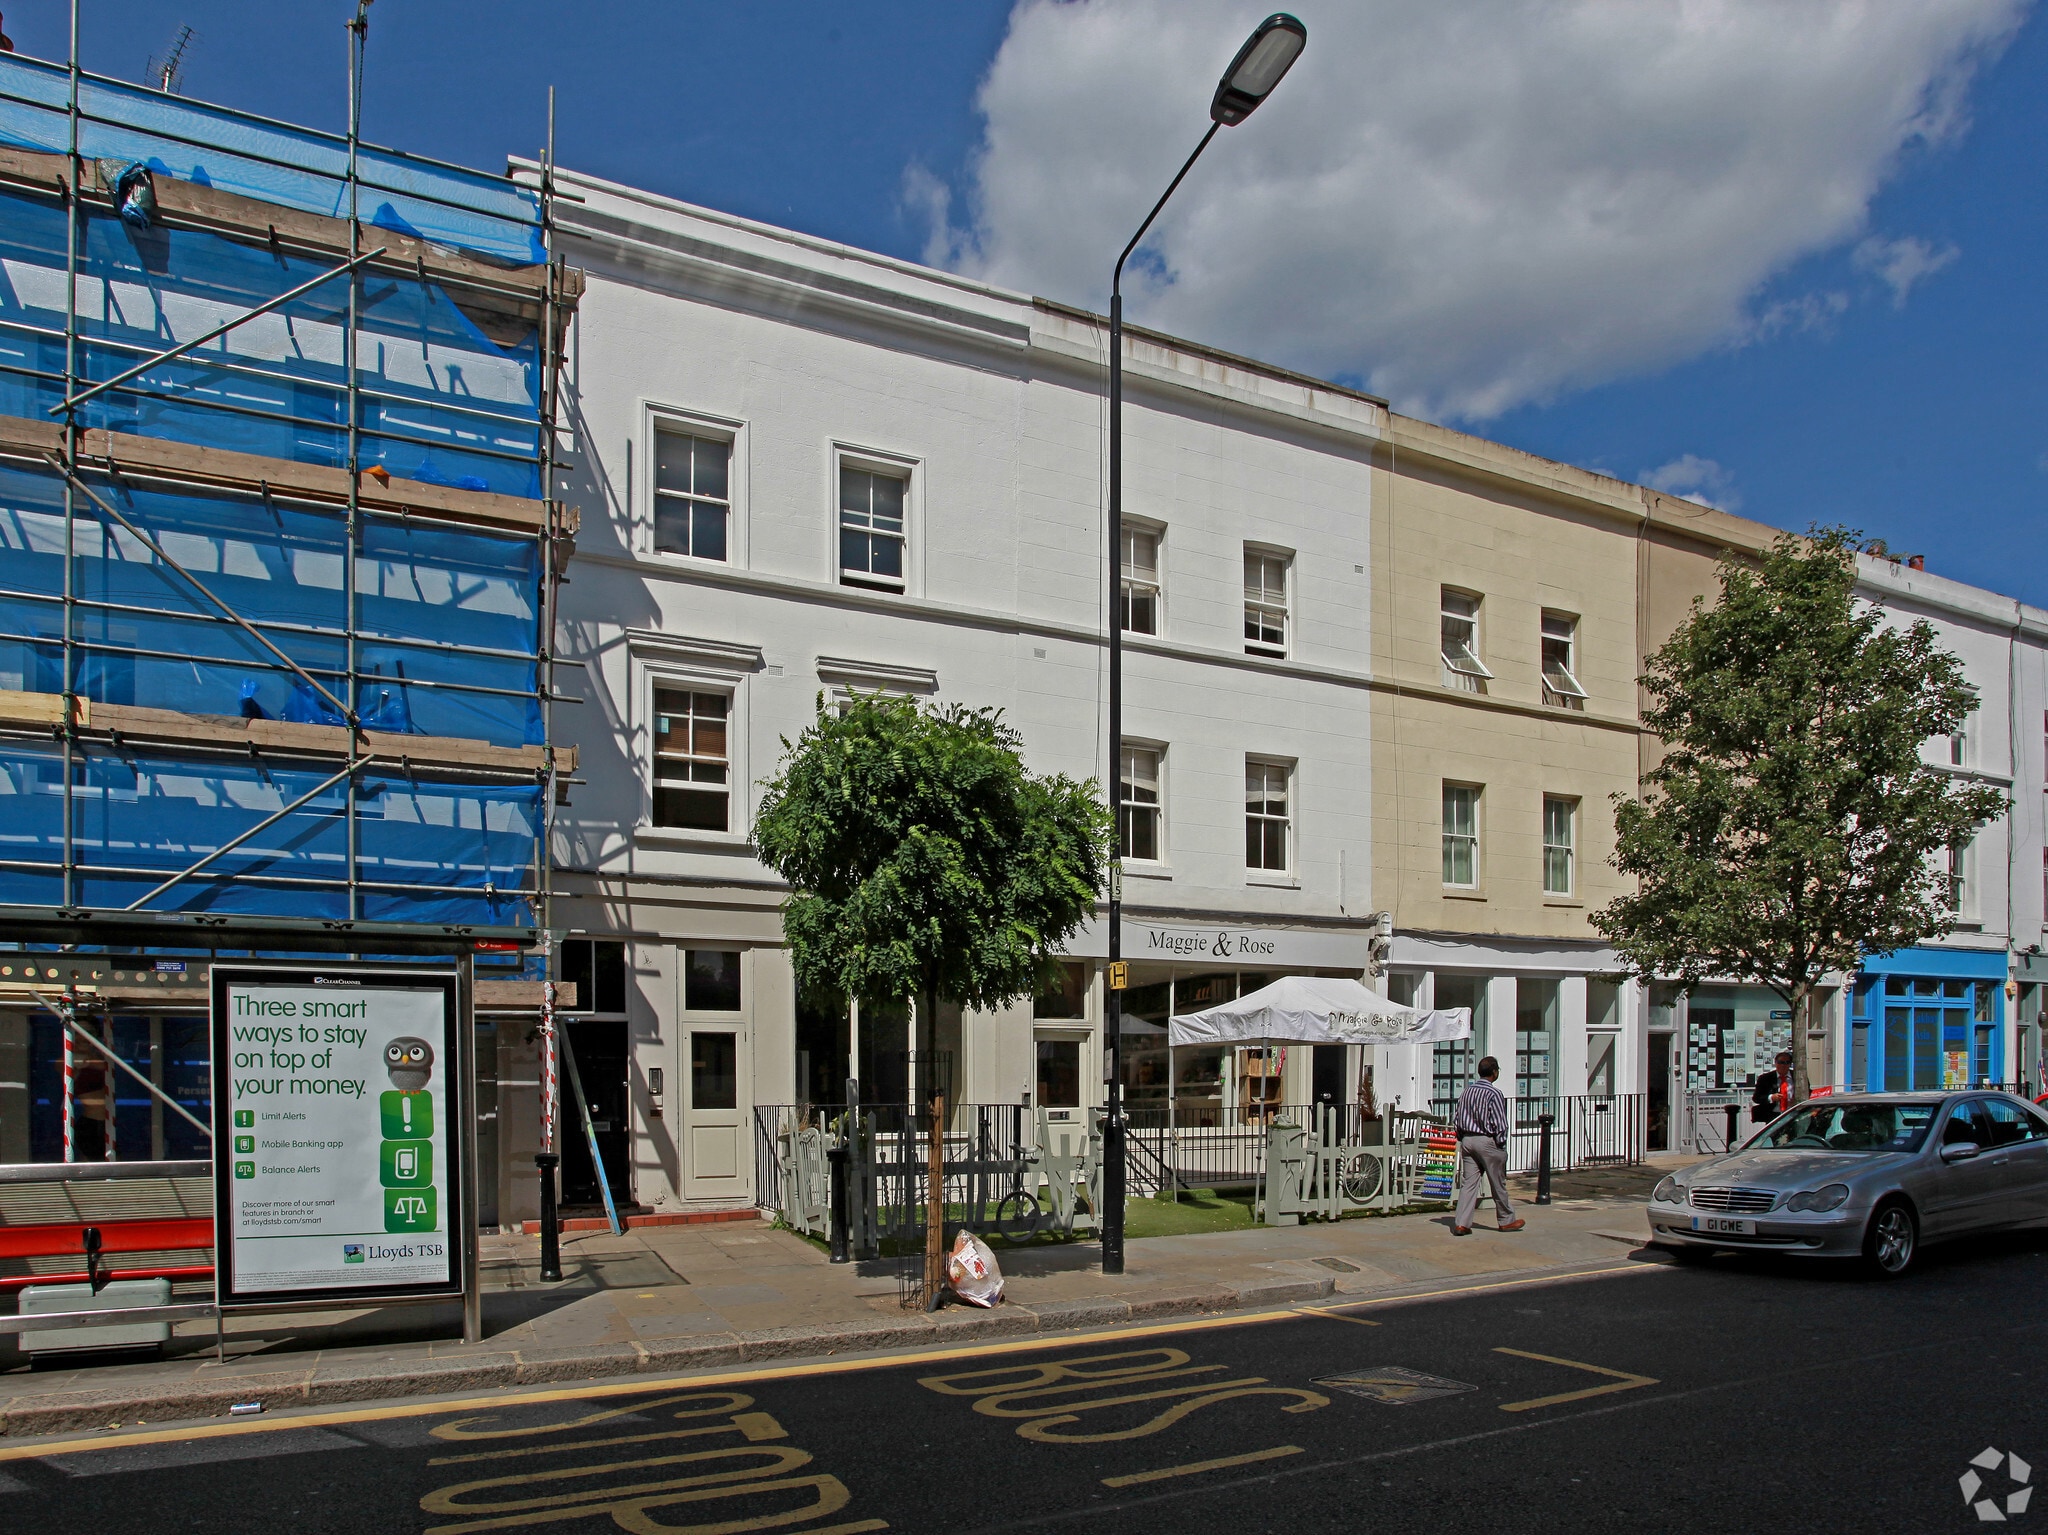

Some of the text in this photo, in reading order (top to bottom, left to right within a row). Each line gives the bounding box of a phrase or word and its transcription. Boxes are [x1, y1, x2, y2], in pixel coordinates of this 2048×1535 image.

[1148, 931, 1275, 957] Maggie & Rose
[1113, 964, 1126, 987] H
[233, 995, 367, 1018] Three smart
[233, 1024, 367, 1049] ways to stay
[234, 1048, 332, 1074] on top of
[235, 1079, 366, 1099] your money.
[261, 1112, 306, 1120] Limit Alerts
[261, 1140, 343, 1149] Mobile Banking app
[262, 1165, 320, 1174] Balance Alerts
[251, 1217, 322, 1227] lloydstsb.com/smart
[369, 1244, 443, 1261] Lloyds TSB
[916, 1347, 1331, 1443] BUS
